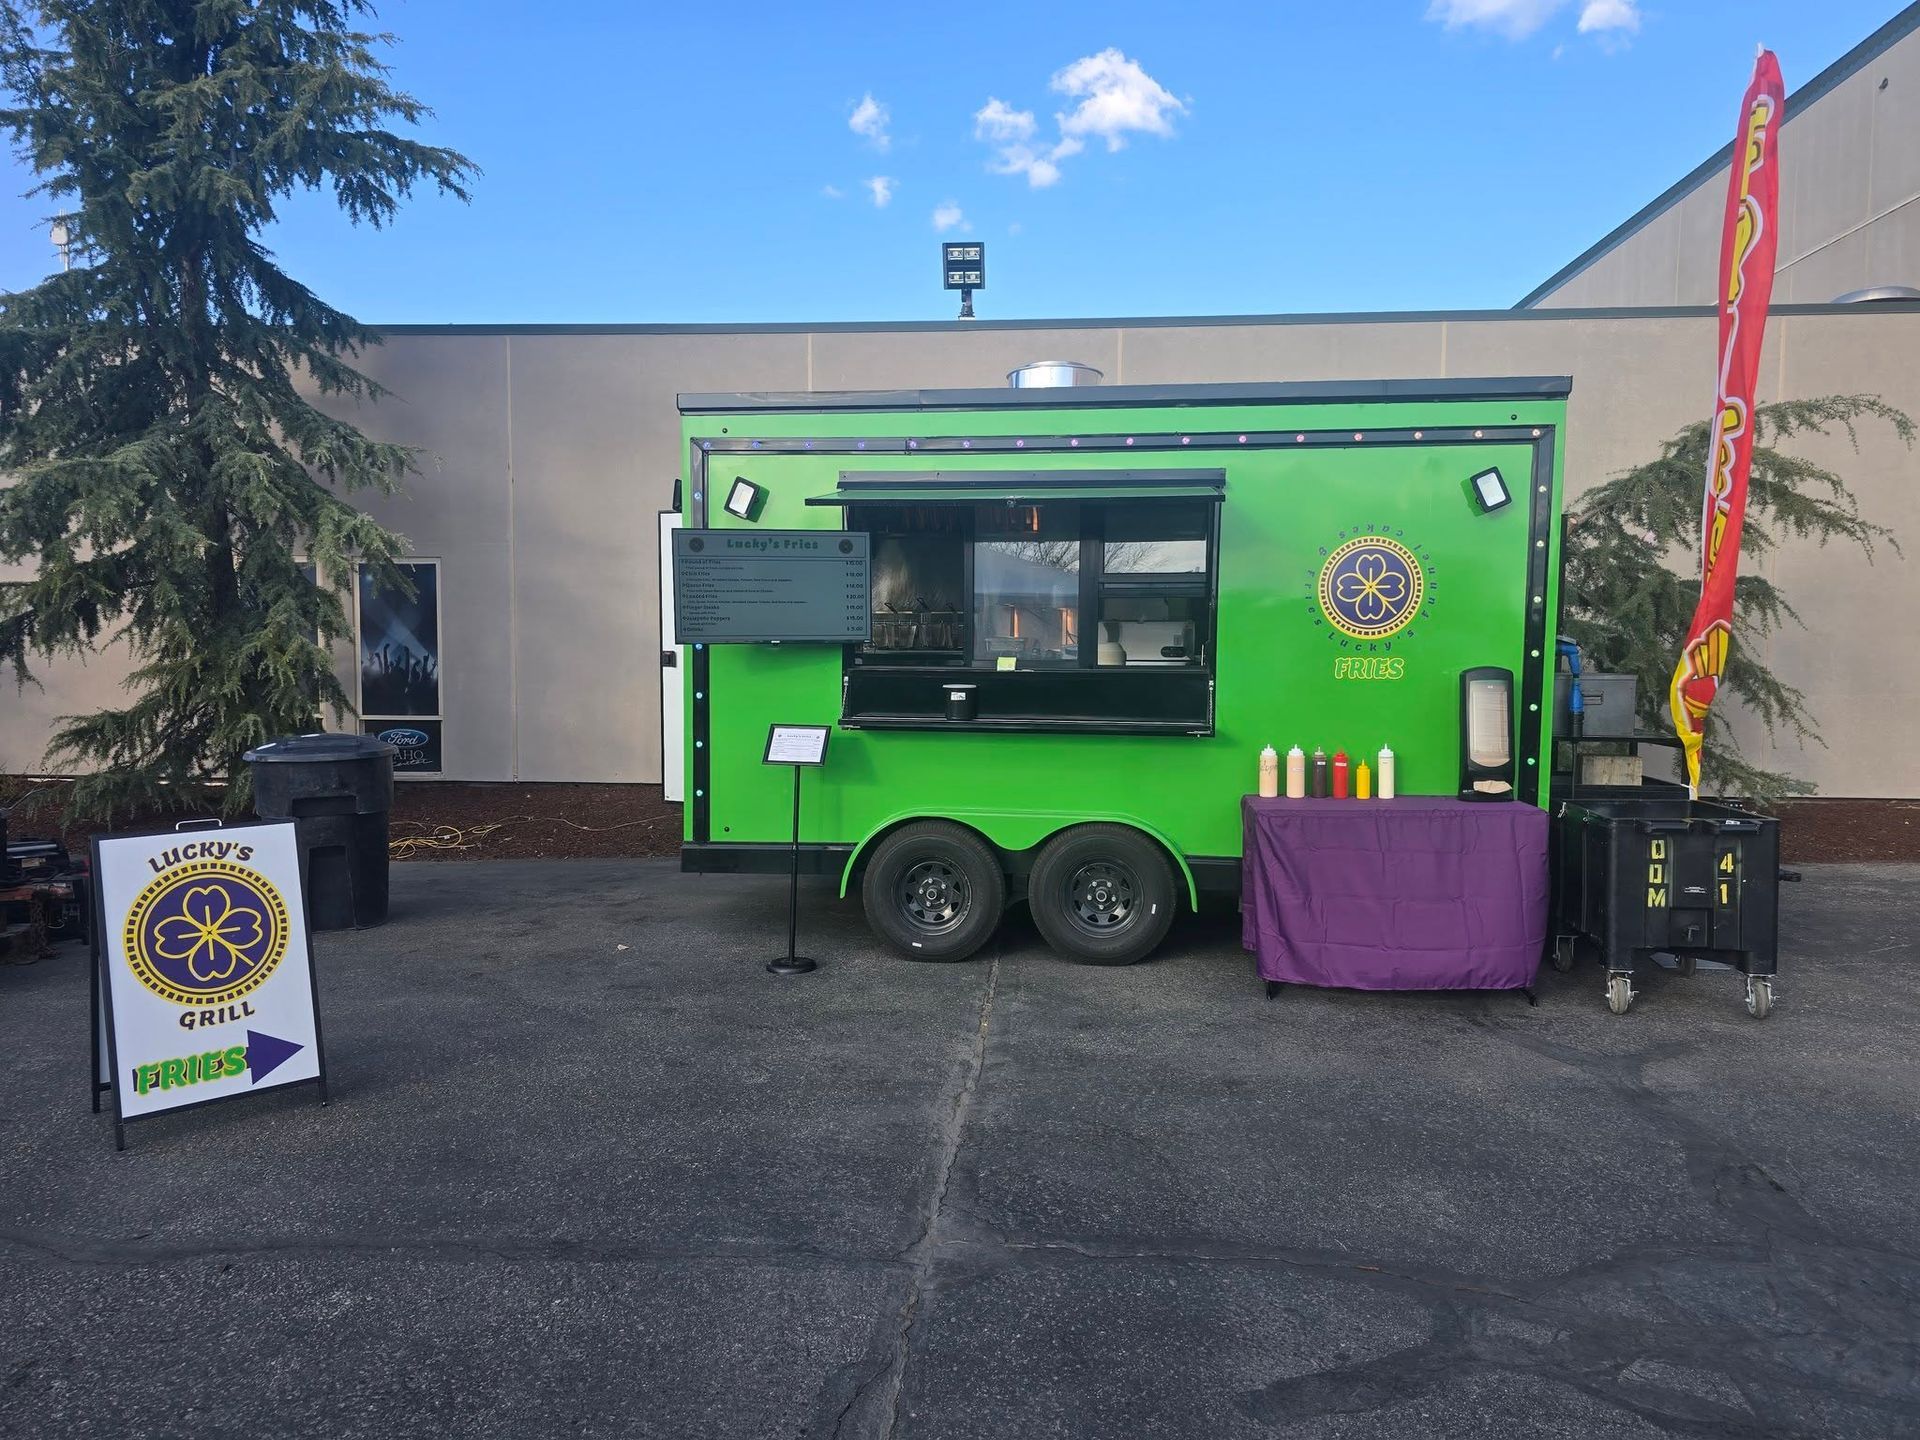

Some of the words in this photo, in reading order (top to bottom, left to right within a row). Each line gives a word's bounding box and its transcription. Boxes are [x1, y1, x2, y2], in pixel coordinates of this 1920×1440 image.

[727, 537, 779, 552] Lucky's
[783, 538, 818, 550] Fries
[1328, 629, 1414, 651] Lucky's
[1334, 657, 1405, 679] FRIES
[387, 731, 419, 745] Ford
[393, 749, 424, 760] AHO
[148, 840, 255, 874] LUCKY'S
[179, 1000, 256, 1031] GRILL
[135, 1045, 249, 1096] FRIES
